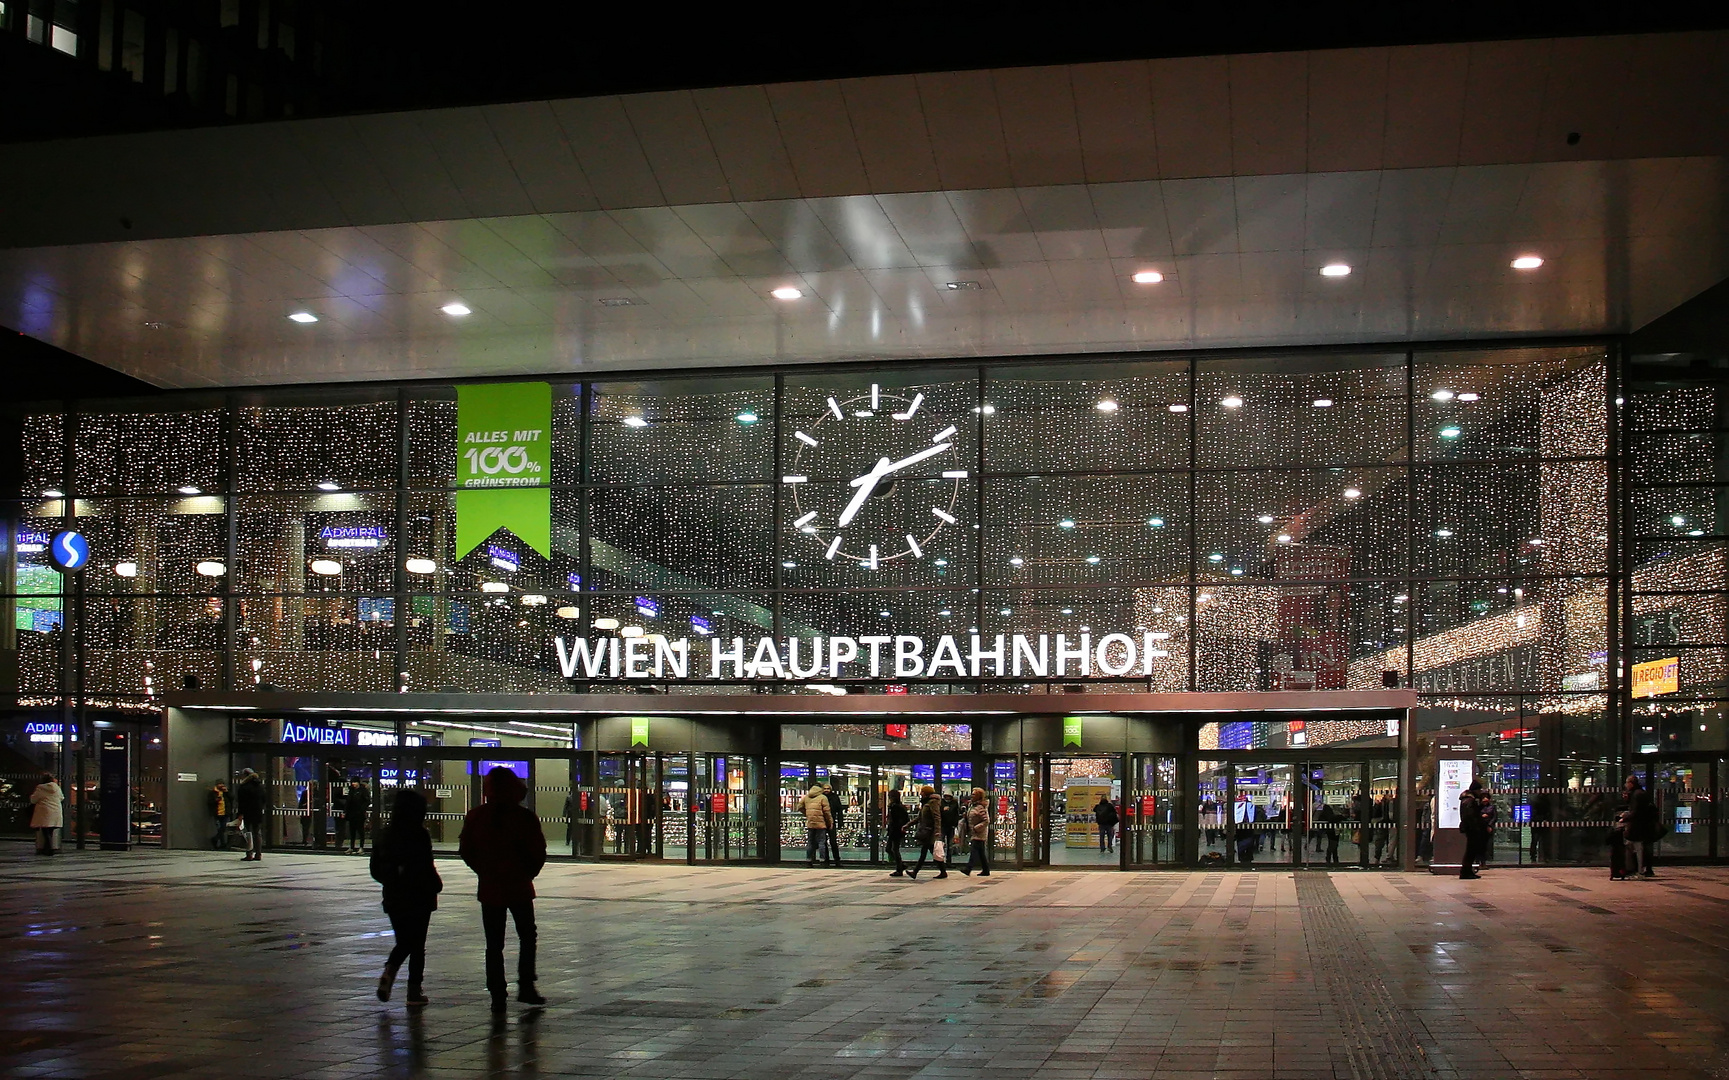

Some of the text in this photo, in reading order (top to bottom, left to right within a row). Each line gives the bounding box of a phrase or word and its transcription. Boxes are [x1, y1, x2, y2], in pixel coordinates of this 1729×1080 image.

[464, 430, 542, 443] ALLES MIT
[463, 446, 542, 474] 100%
[465, 476, 541, 487] GRÜNSTROM
[321, 526, 387, 538] ADMIRAL
[555, 631, 1170, 680] WIEN HAUPTBAHNHOF
